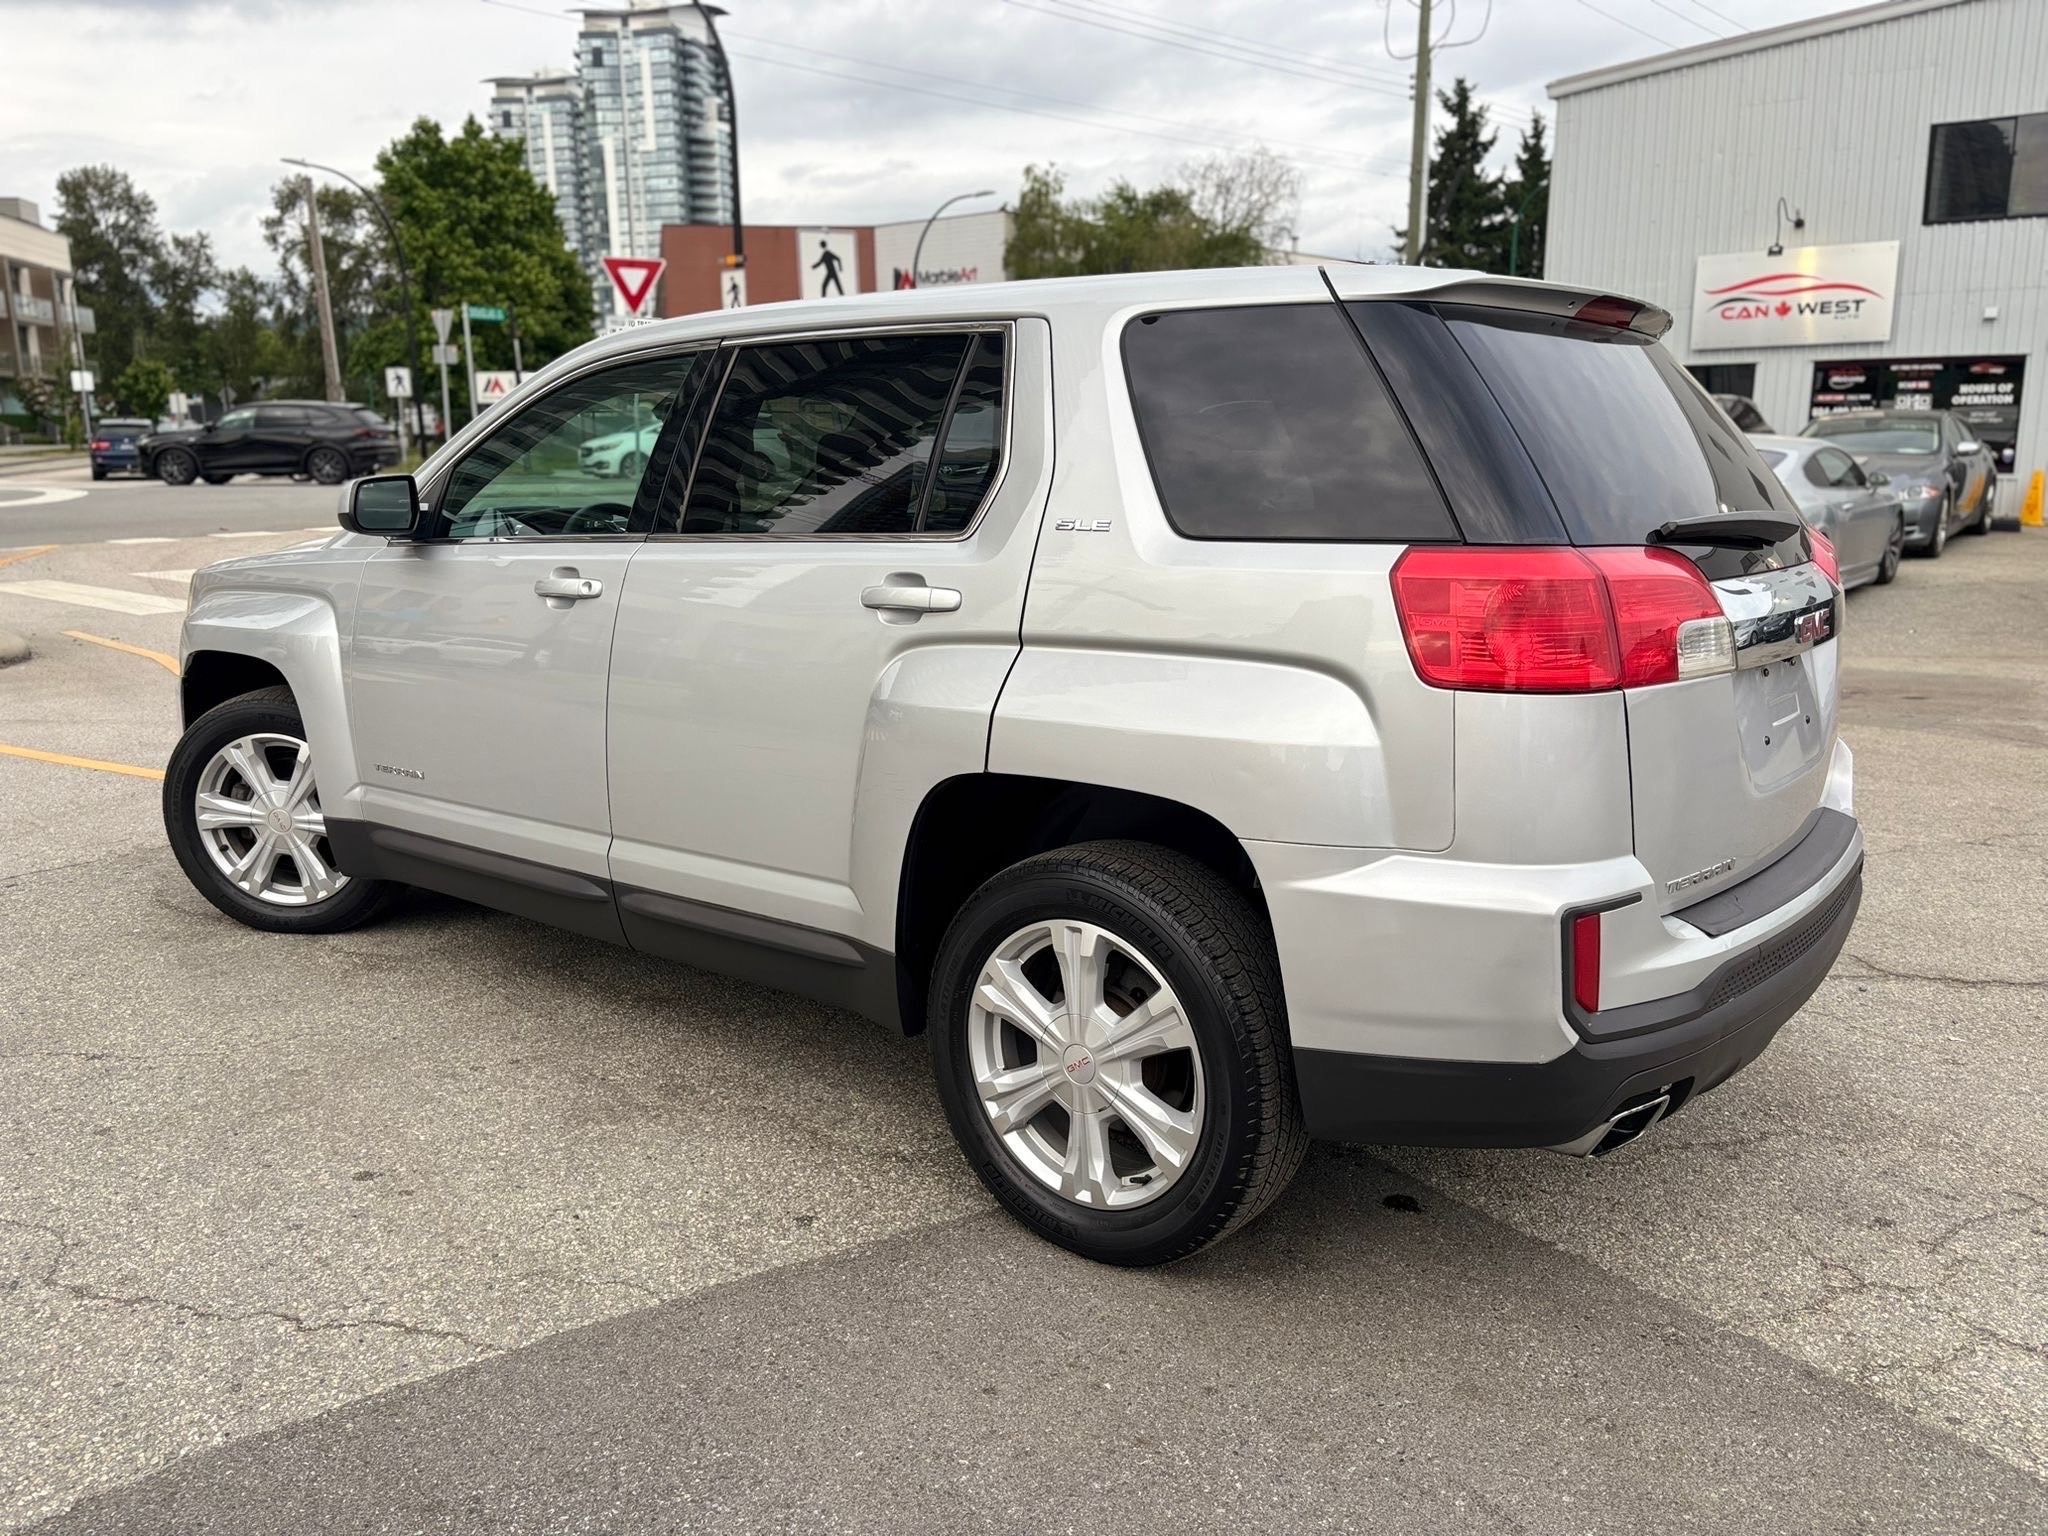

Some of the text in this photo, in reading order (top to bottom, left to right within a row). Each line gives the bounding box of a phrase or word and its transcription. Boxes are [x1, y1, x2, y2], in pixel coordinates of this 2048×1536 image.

[1720, 298, 1867, 320] CAN WEST
[1958, 382, 2015, 395] HOURS OF
[1950, 393, 2015, 406] OPERATION
[1055, 519, 1112, 533] SLE
[1794, 607, 1831, 644] GMC
[1665, 857, 1737, 896] TERRAIN
[1066, 1056, 1091, 1073] GMC
